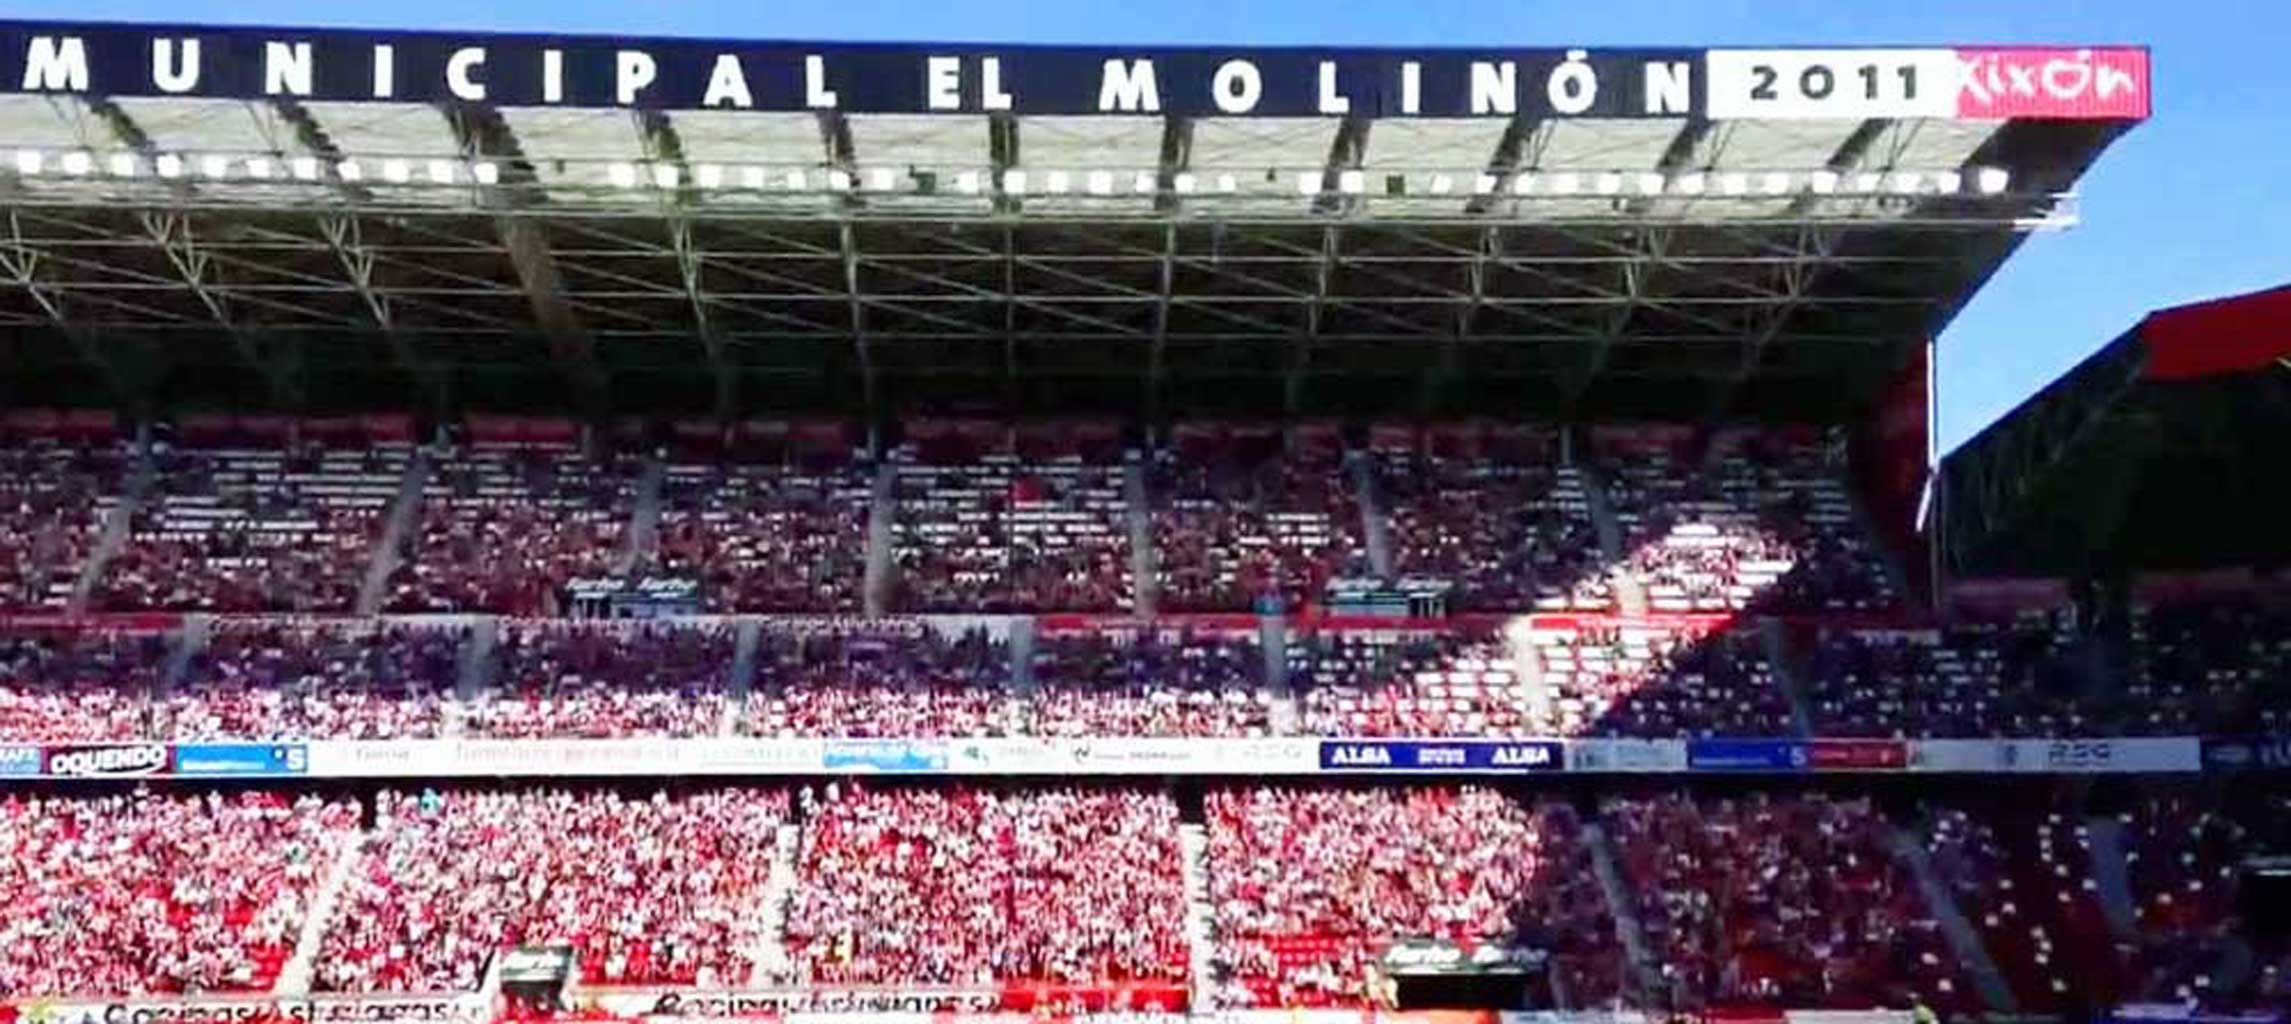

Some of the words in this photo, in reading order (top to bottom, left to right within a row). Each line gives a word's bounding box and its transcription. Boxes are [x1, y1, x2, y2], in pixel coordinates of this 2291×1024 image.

[23, 36, 837, 108] MUNICIPAL
[928, 56, 1012, 110] EL
[1098, 49, 1690, 114] MOLINÓN
[1750, 65, 1917, 100] 2011
[51, 744, 167, 774] OQUENDO
